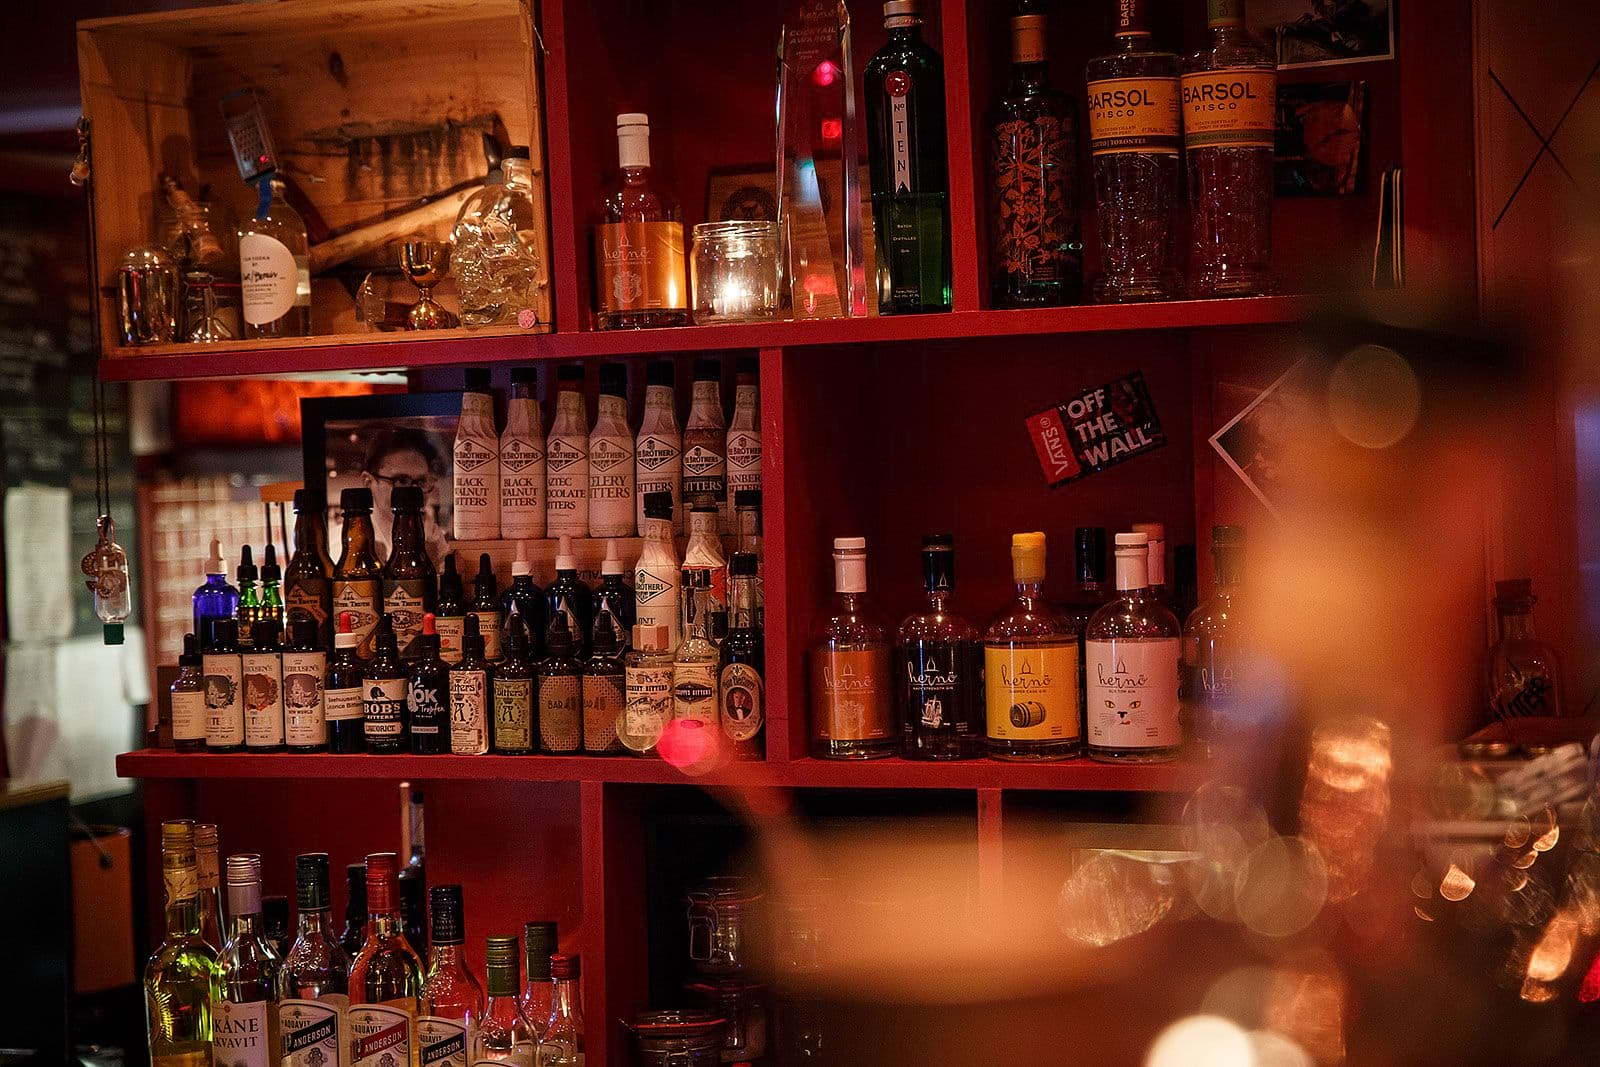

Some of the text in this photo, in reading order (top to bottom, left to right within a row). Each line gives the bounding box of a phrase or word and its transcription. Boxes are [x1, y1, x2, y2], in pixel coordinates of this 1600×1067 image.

[1088, 89, 1155, 111] BARSOL
[1183, 81, 1256, 104] BARSOL
[1096, 109, 1135, 120] PISCO
[1194, 102, 1237, 113] PISCO
[894, 120, 907, 172] TEN
[1075, 412, 1118, 442] THE
[504, 478, 533, 487] BLACK
[907, 661, 958, 686] hernö
[1001, 663, 1053, 689] hernö
[1097, 663, 1149, 689] hernö
[364, 702, 401, 714] BOB'S
[214, 1014, 259, 1033] KÅNE
[293, 1025, 331, 1049] ANDERSON
[364, 1031, 402, 1053] ANDERSON
[427, 1041, 460, 1060] ANDERSON
